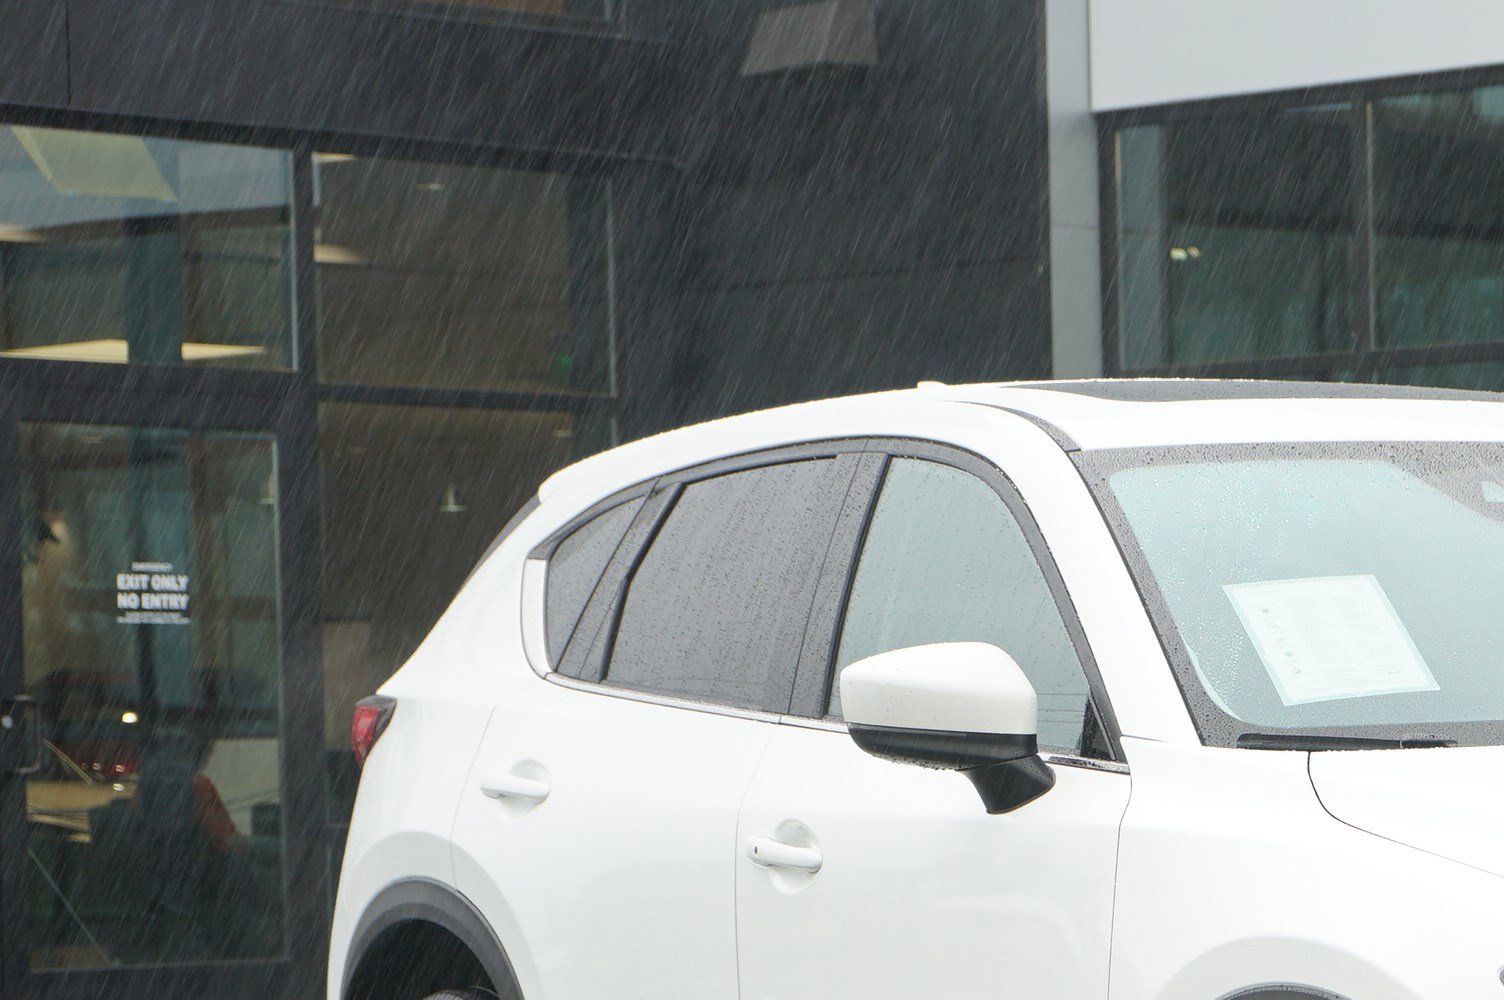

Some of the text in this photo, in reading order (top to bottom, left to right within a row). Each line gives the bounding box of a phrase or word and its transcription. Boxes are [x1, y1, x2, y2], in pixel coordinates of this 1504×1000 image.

[117, 573, 190, 591] EXIT ONLY
[117, 592, 190, 611] NO ENTRY
